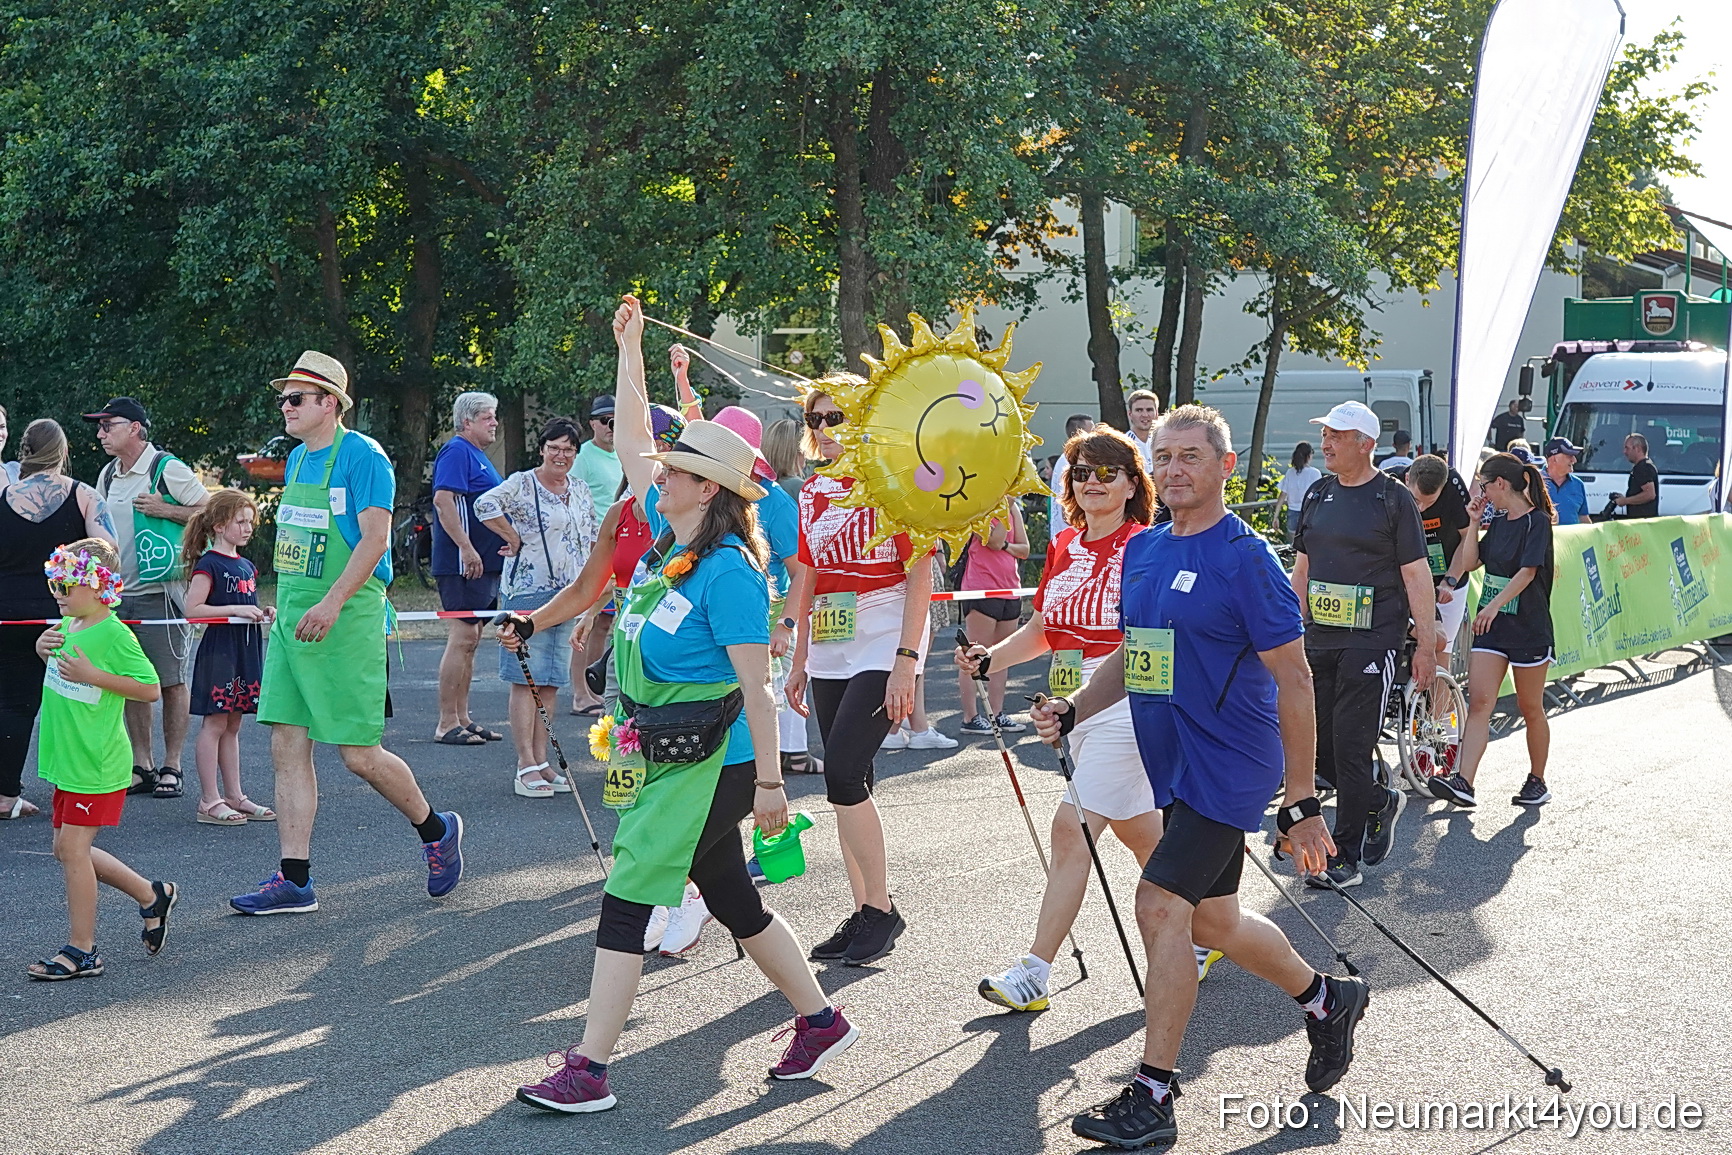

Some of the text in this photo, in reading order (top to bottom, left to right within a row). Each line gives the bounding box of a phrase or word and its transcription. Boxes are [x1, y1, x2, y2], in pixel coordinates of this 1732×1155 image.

[1579, 379, 1621, 390] abavent
[276, 541, 301, 561] 1446
[299, 548, 308, 570] 2022
[1315, 597, 1341, 612] 499
[817, 610, 847, 627] 1115
[1053, 667, 1073, 686] 1121
[1131, 673, 1155, 682] Michael
[1160, 655, 1169, 685] 2022
